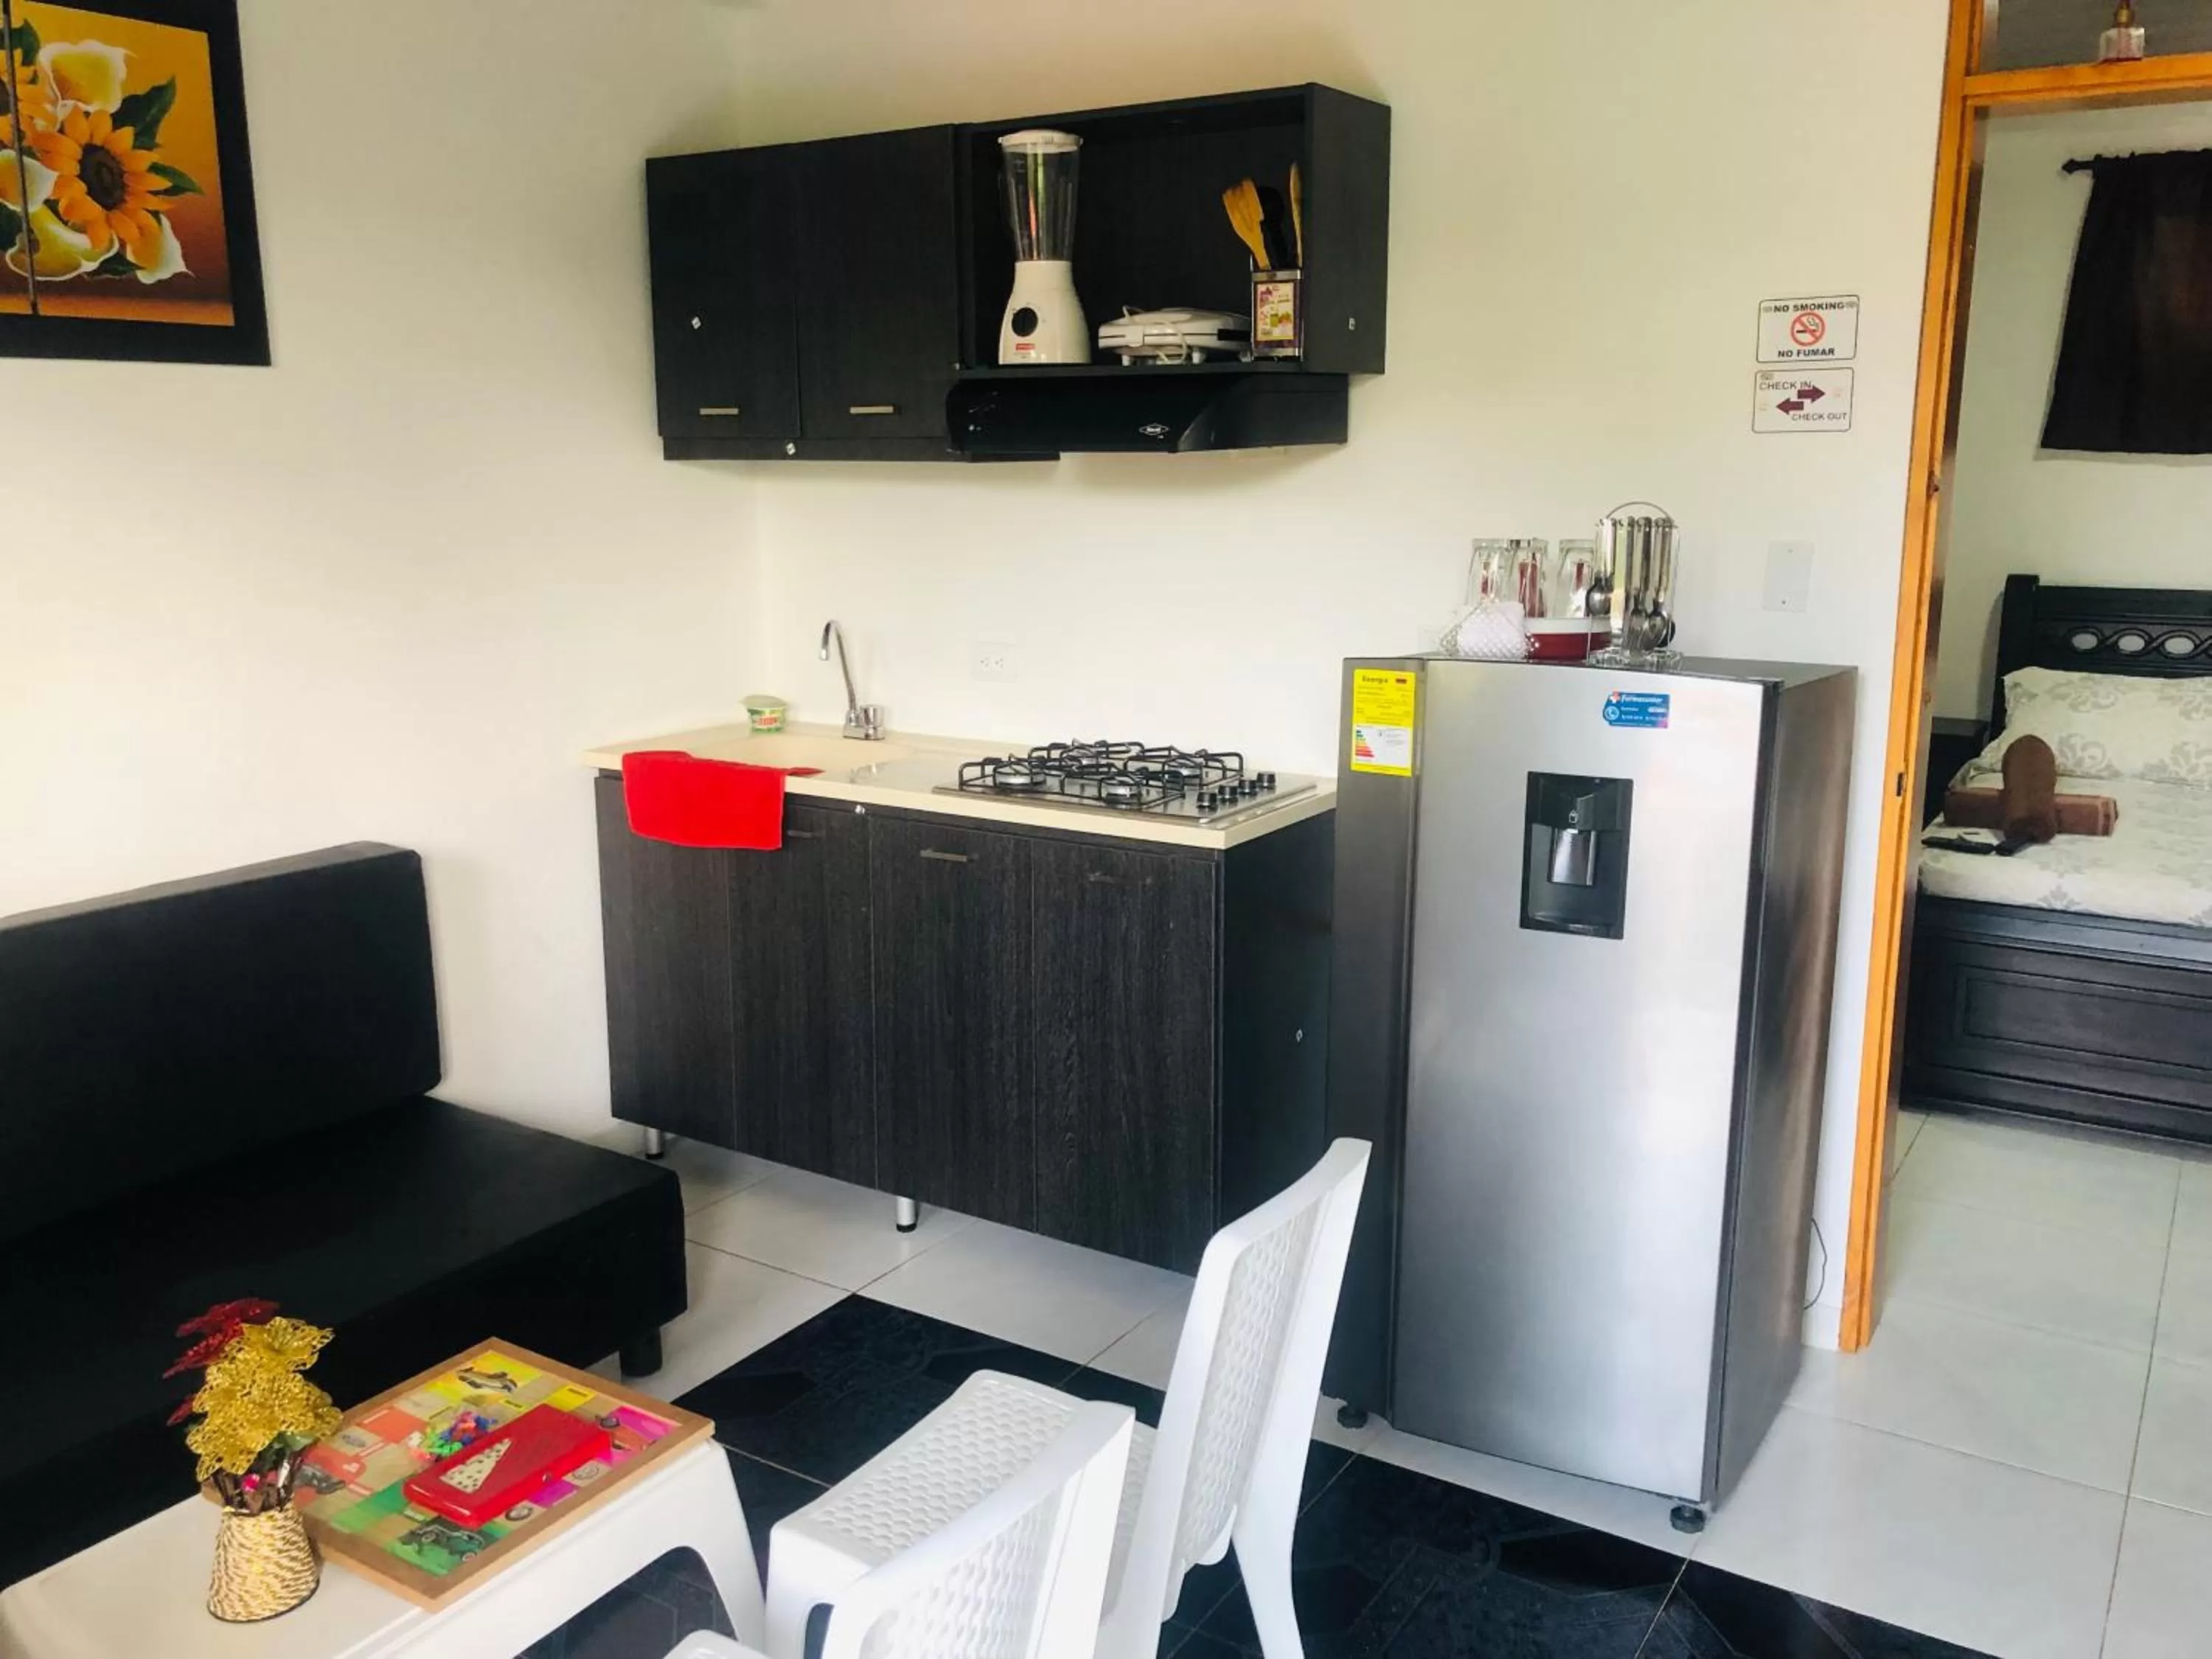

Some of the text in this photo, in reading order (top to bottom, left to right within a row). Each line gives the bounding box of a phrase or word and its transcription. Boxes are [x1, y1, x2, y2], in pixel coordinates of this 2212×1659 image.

[1773, 302, 1845, 313] NO SMOKING
[1797, 347, 1835, 357] FUMAR
[1759, 381, 1797, 390] CHECK
[1792, 412, 1847, 421] CHECK OUT
